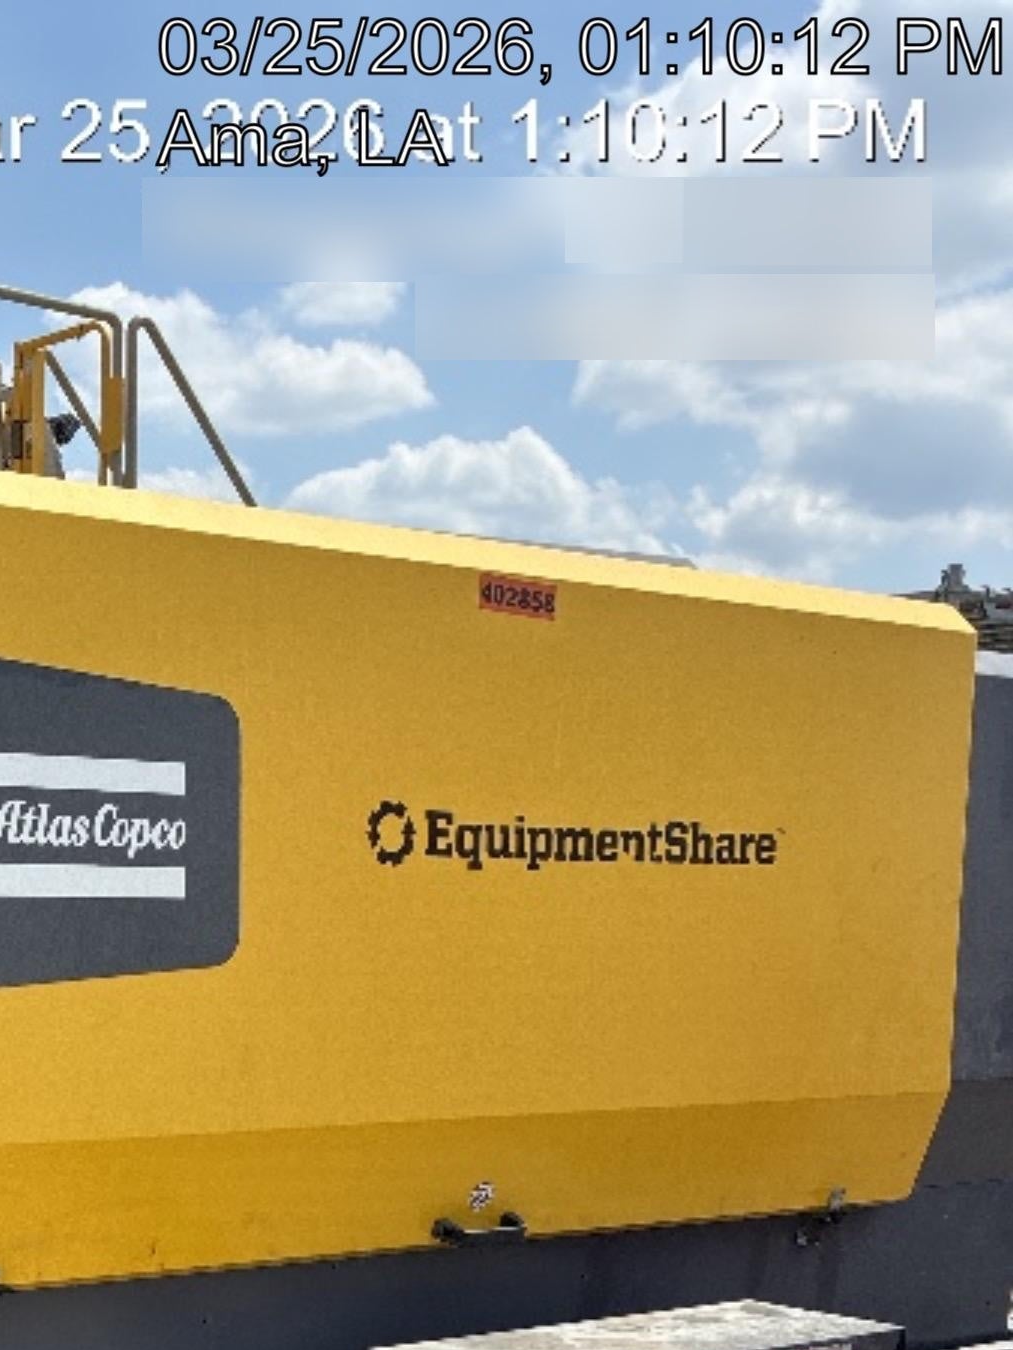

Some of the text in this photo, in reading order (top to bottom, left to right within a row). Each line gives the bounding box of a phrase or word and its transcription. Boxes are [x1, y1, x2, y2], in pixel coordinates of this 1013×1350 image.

[482, 581, 556, 614] 402858
[94, 803, 187, 860] Copco
[425, 809, 778, 872] EquipmentShare
